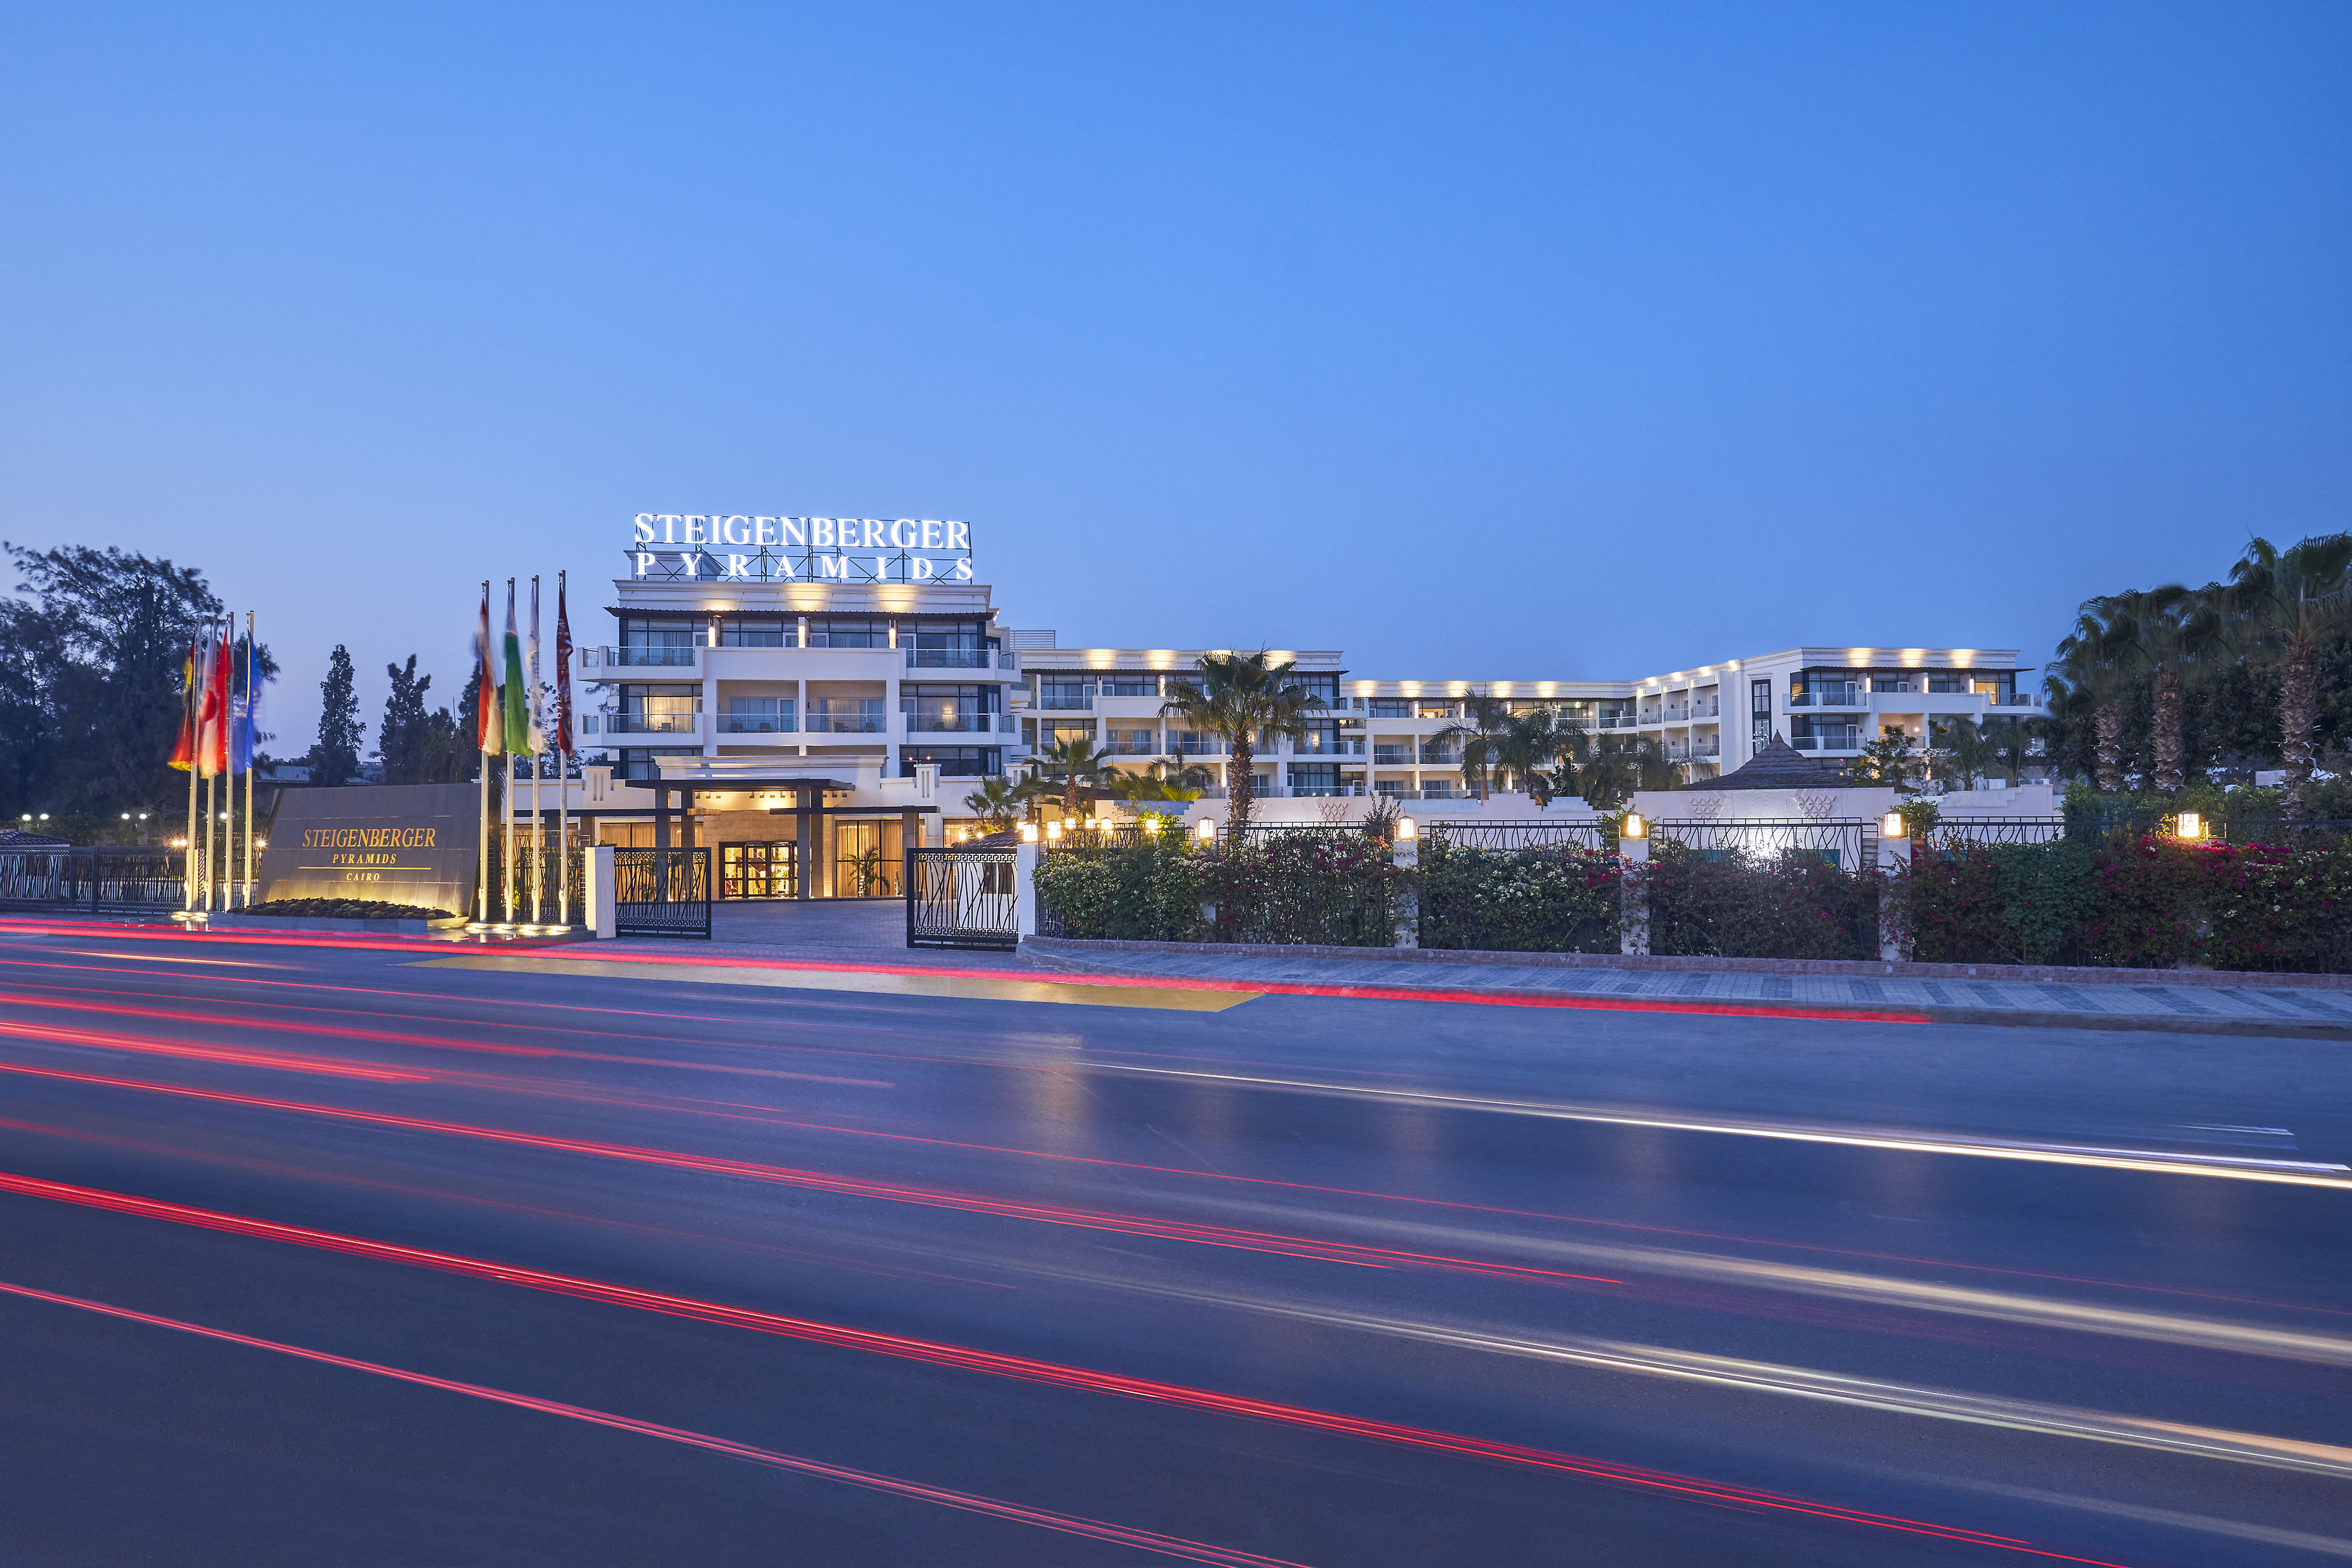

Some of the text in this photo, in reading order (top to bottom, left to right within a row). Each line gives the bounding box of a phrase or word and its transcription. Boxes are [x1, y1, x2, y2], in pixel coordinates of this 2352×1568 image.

[635, 513, 971, 549] STEIGENBERGER
[637, 553, 972, 580] PYRAMIDS
[302, 828, 436, 847] STEIGENBERGER
[332, 854, 396, 864] PYRAMIDS
[346, 873, 380, 881] CAIRO
